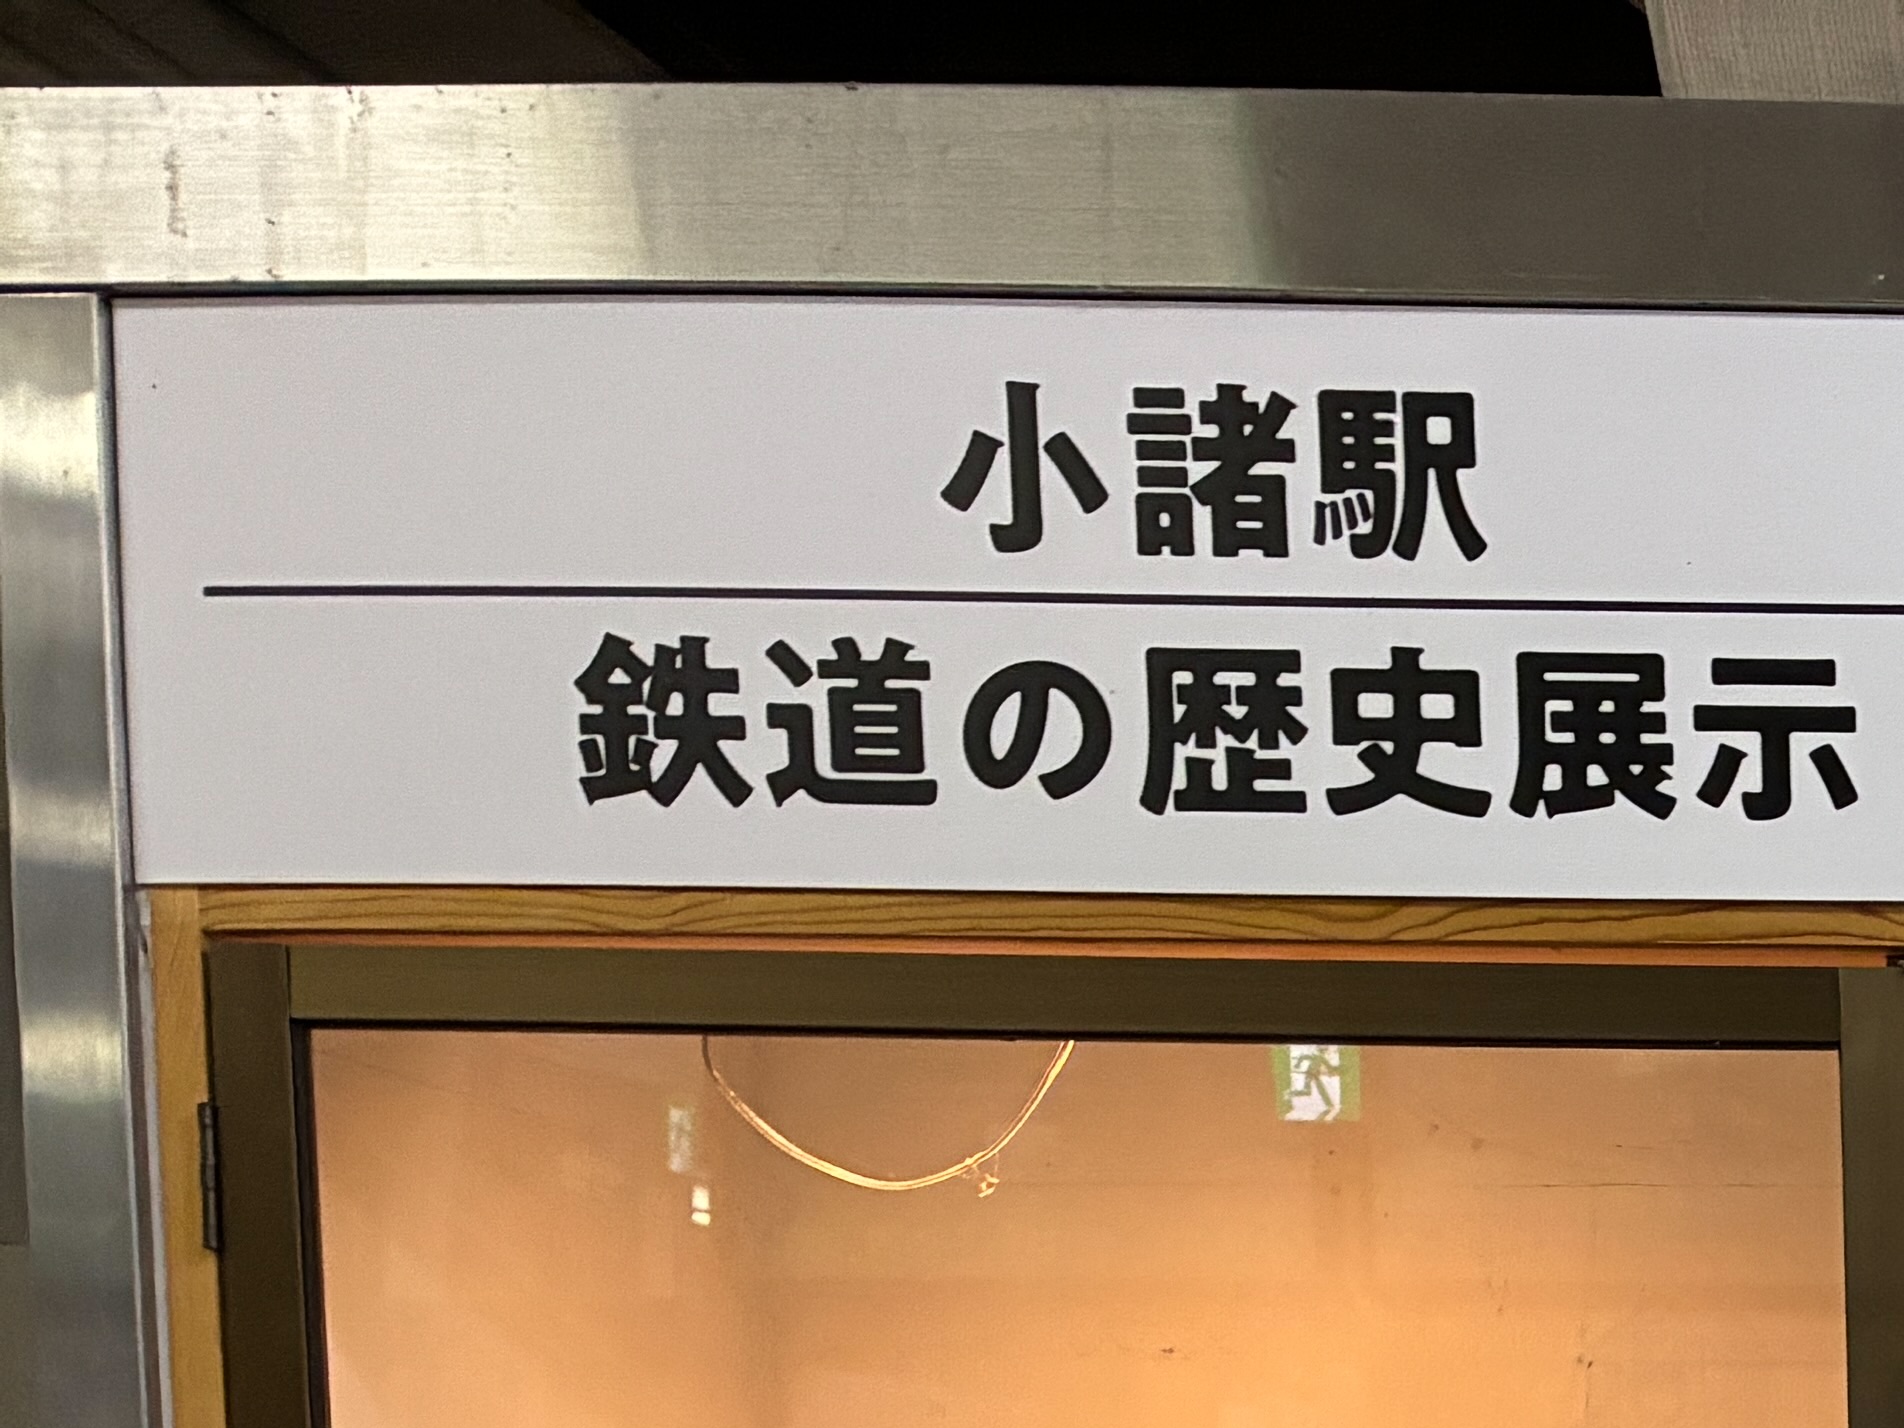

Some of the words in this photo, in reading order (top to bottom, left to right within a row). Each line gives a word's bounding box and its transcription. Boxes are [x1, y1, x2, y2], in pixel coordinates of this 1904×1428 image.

[939, 383, 1487, 564] 小諸駅
[573, 633, 1859, 822] 鉄道の歴史展示
